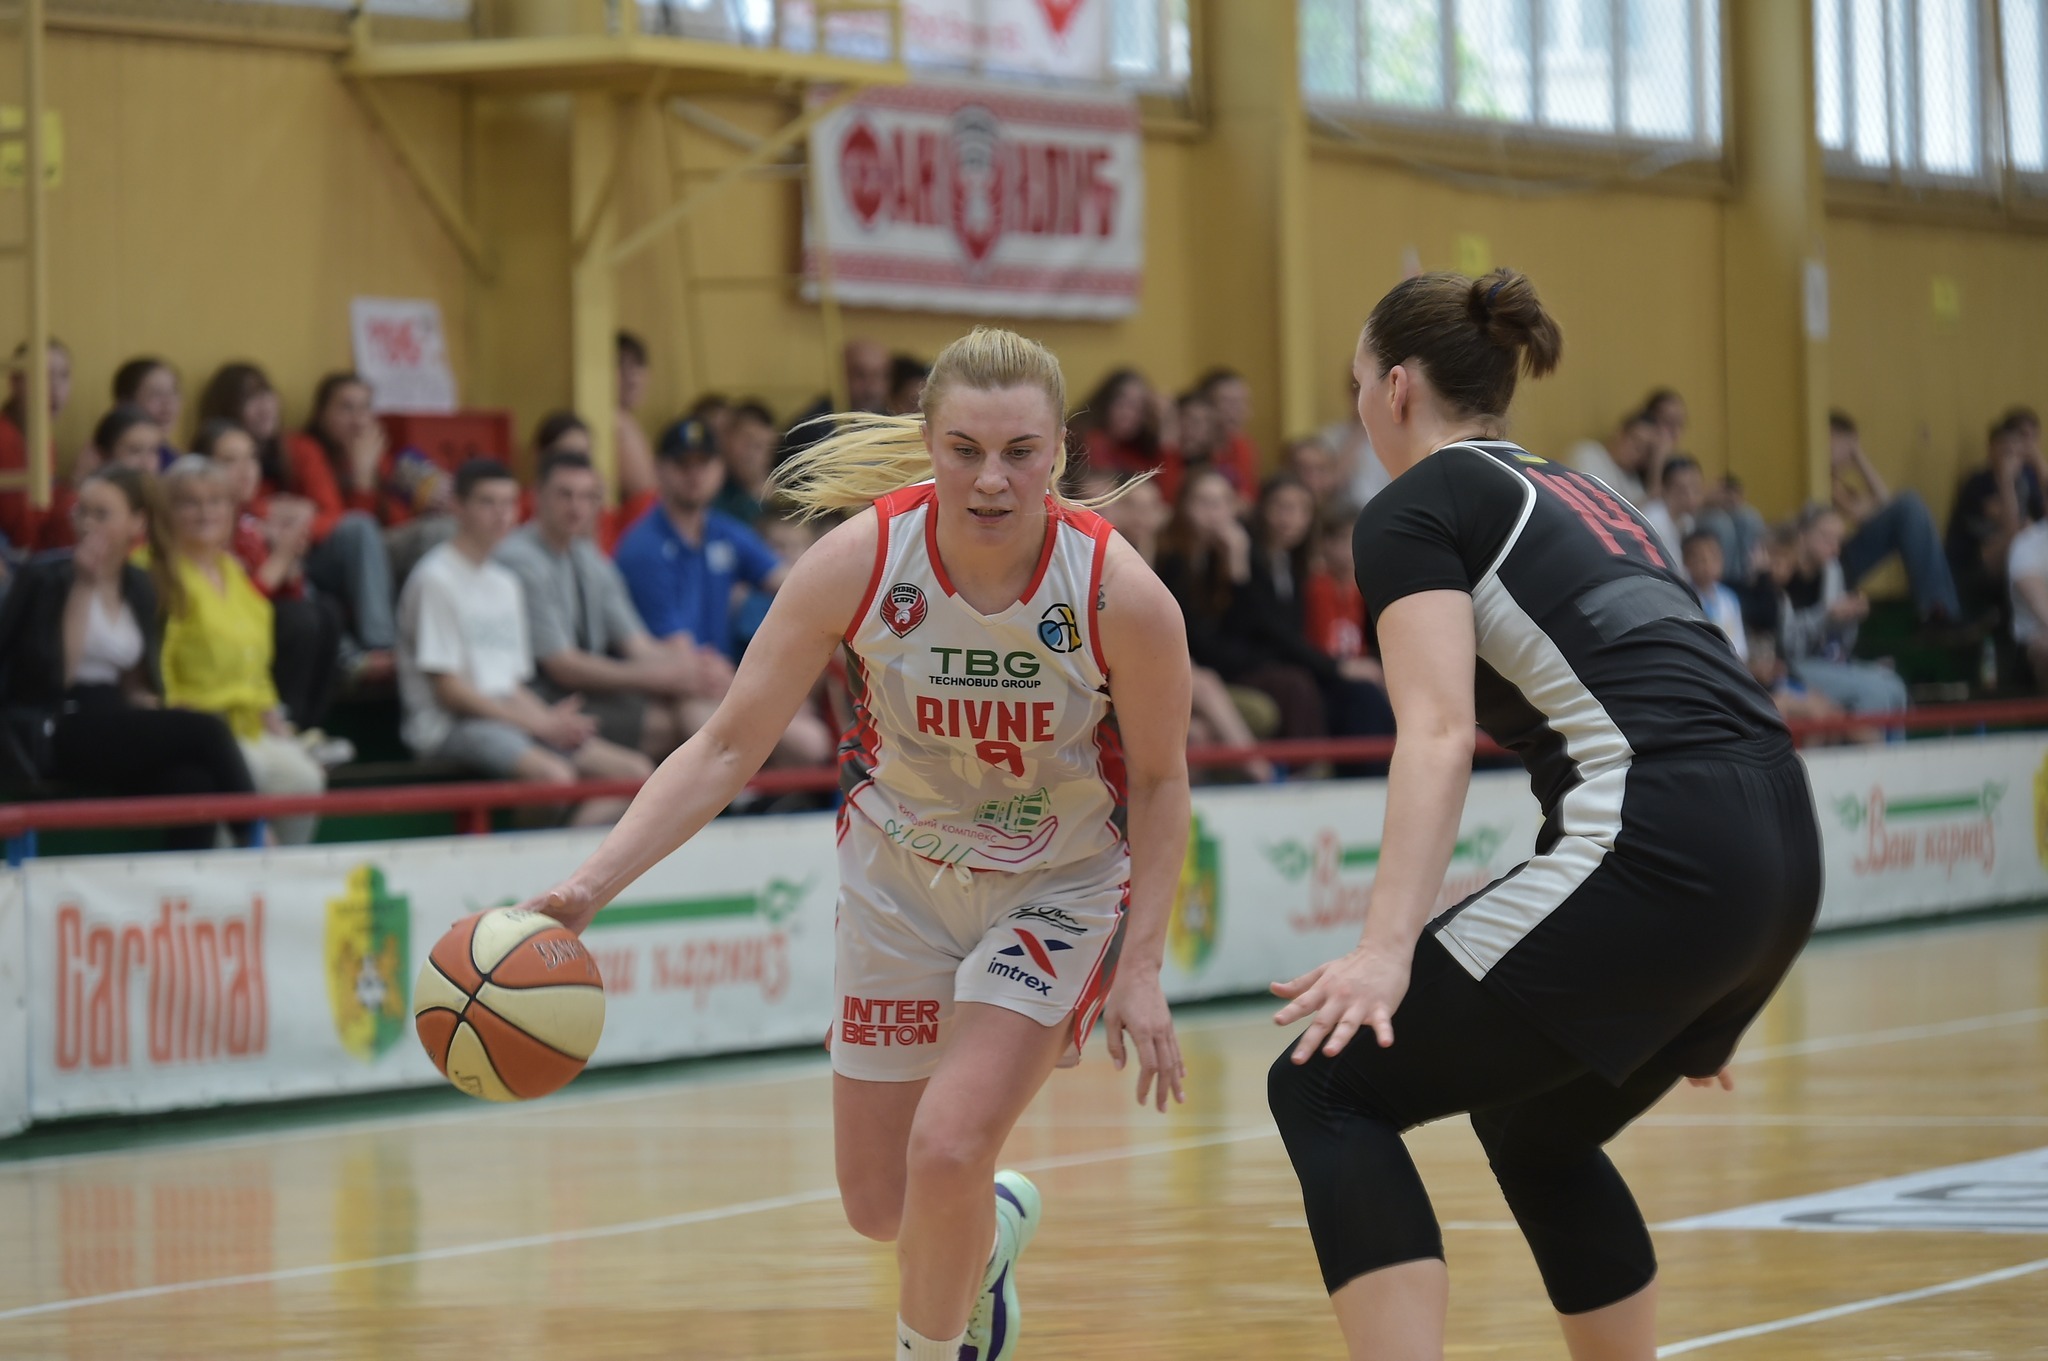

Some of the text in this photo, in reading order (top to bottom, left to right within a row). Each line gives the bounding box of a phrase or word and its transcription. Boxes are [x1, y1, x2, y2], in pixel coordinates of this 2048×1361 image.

[1526, 466, 1668, 569] 14
[930, 647, 1041, 679] TBG
[928, 675, 1042, 689] TECHNOBUD GROUP
[916, 695, 1055, 743] RIVNE
[55, 892, 267, 1072] Cardinal
[987, 957, 1053, 997] imtrex
[843, 996, 940, 1024] INTER
[842, 1020, 939, 1047] BETON
